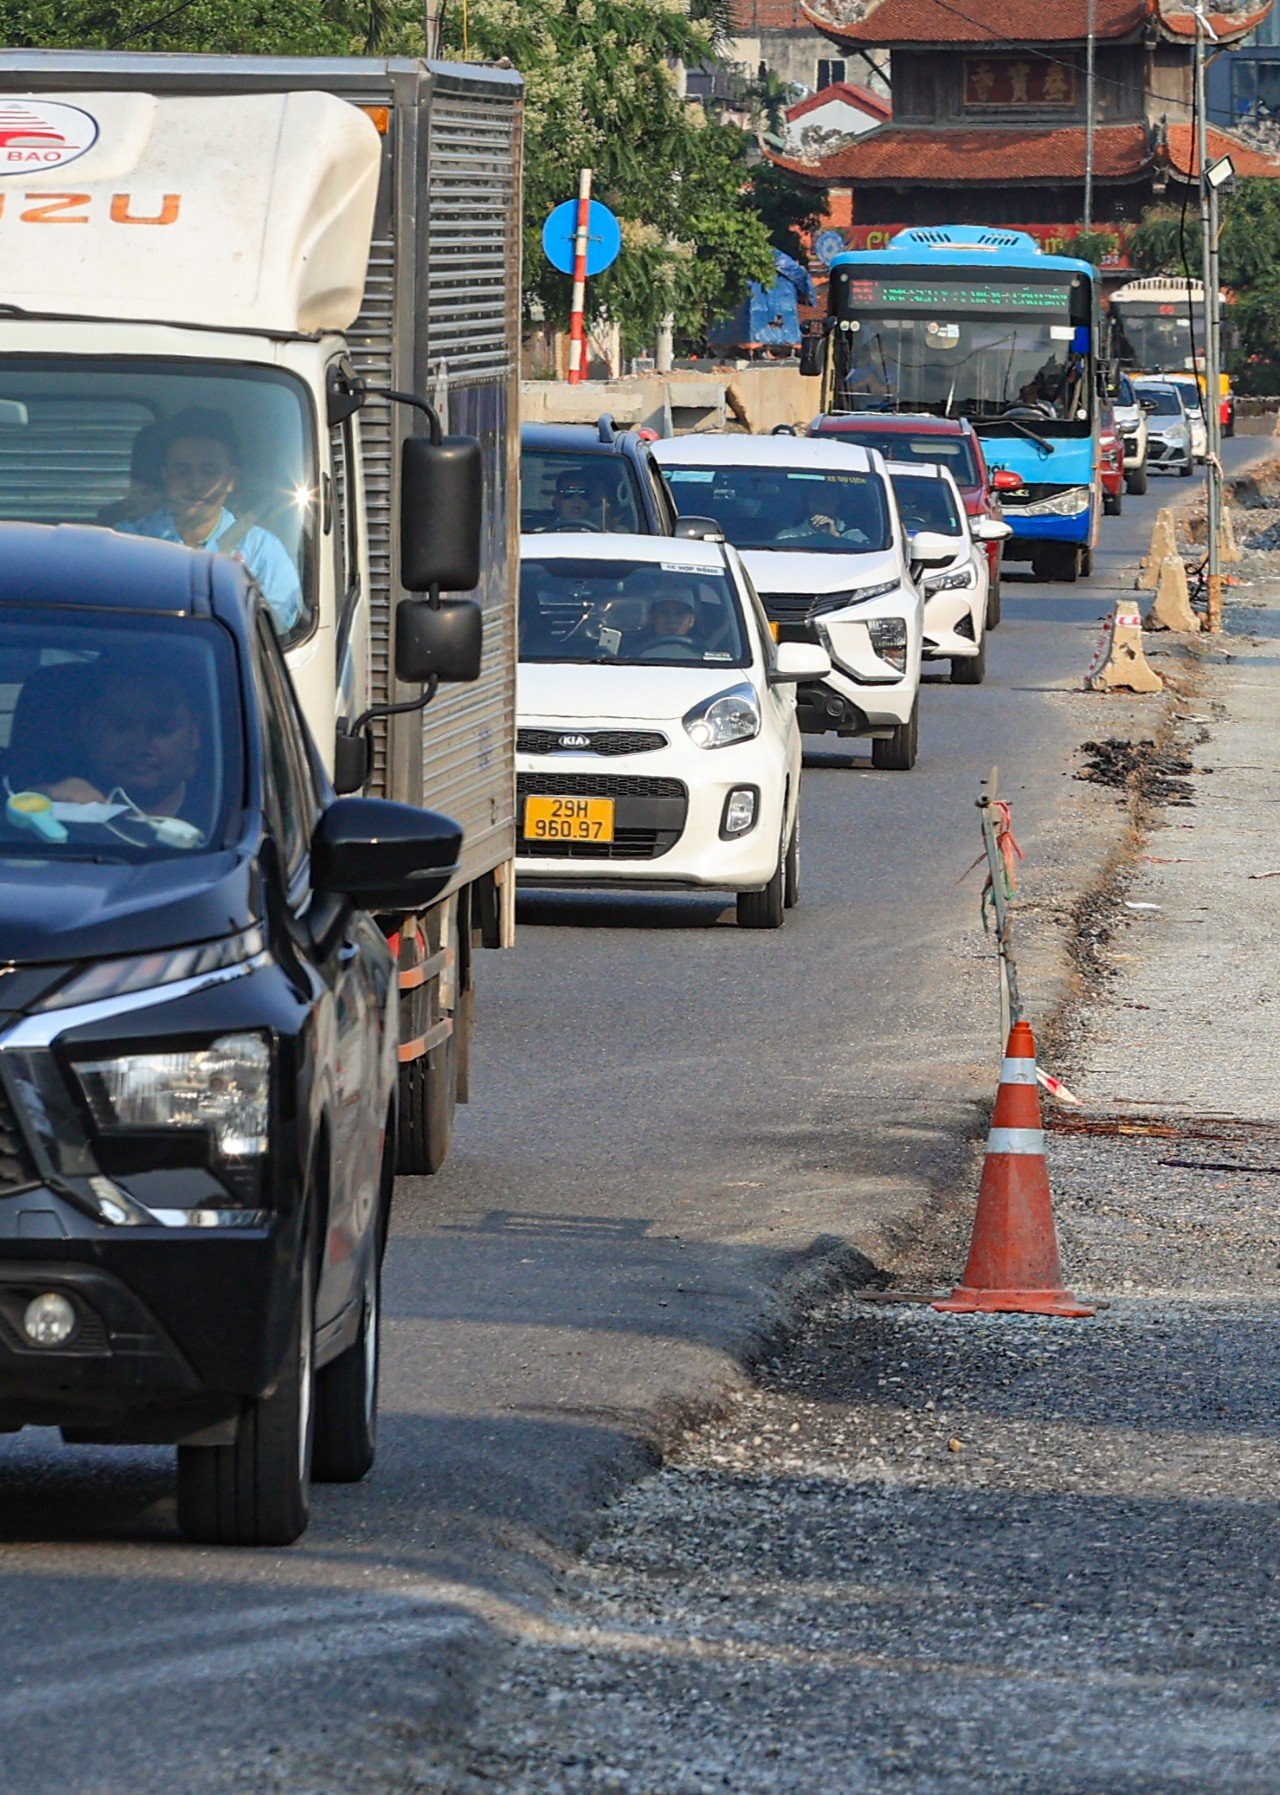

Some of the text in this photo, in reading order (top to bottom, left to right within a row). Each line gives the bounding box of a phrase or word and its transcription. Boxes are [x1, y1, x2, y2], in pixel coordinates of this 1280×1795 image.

[8, 150, 62, 163] BAO
[563, 735, 584, 746] KIA
[551, 799, 589, 818] 29H
[535, 819, 603, 839] 960.97
